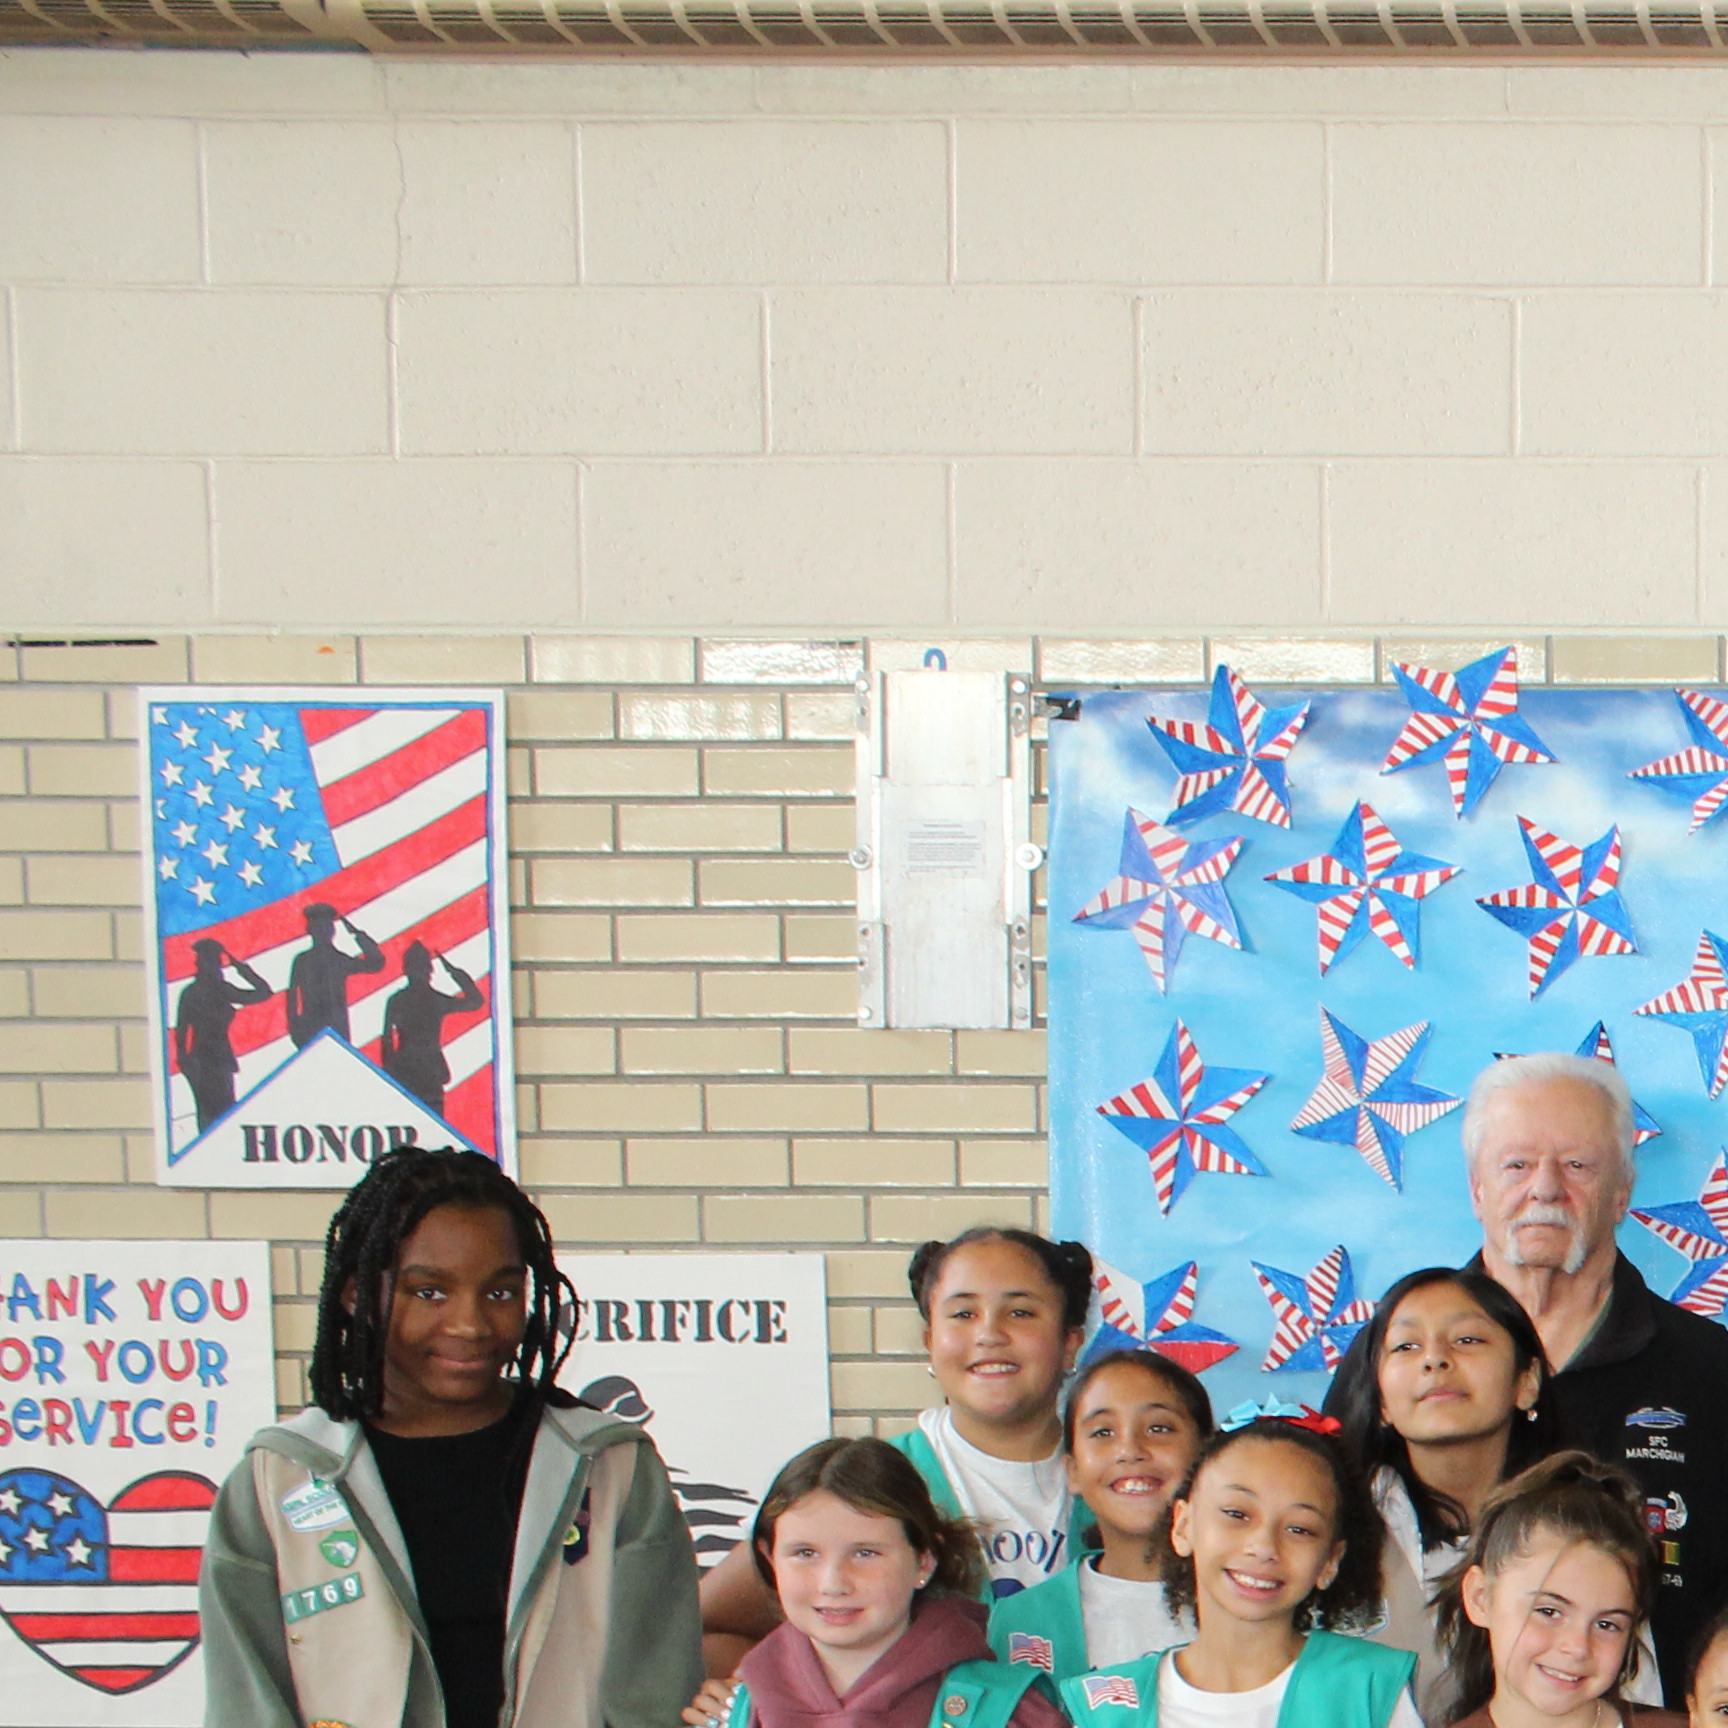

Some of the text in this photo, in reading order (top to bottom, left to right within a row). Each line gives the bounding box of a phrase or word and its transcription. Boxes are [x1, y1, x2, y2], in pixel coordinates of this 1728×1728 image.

[0, 1273, 248, 1324] ANK YOU
[557, 1299, 788, 1344] CRIFICE
[0, 1335, 229, 1387] OR YOUR
[286, 1576, 358, 1617] 1769
